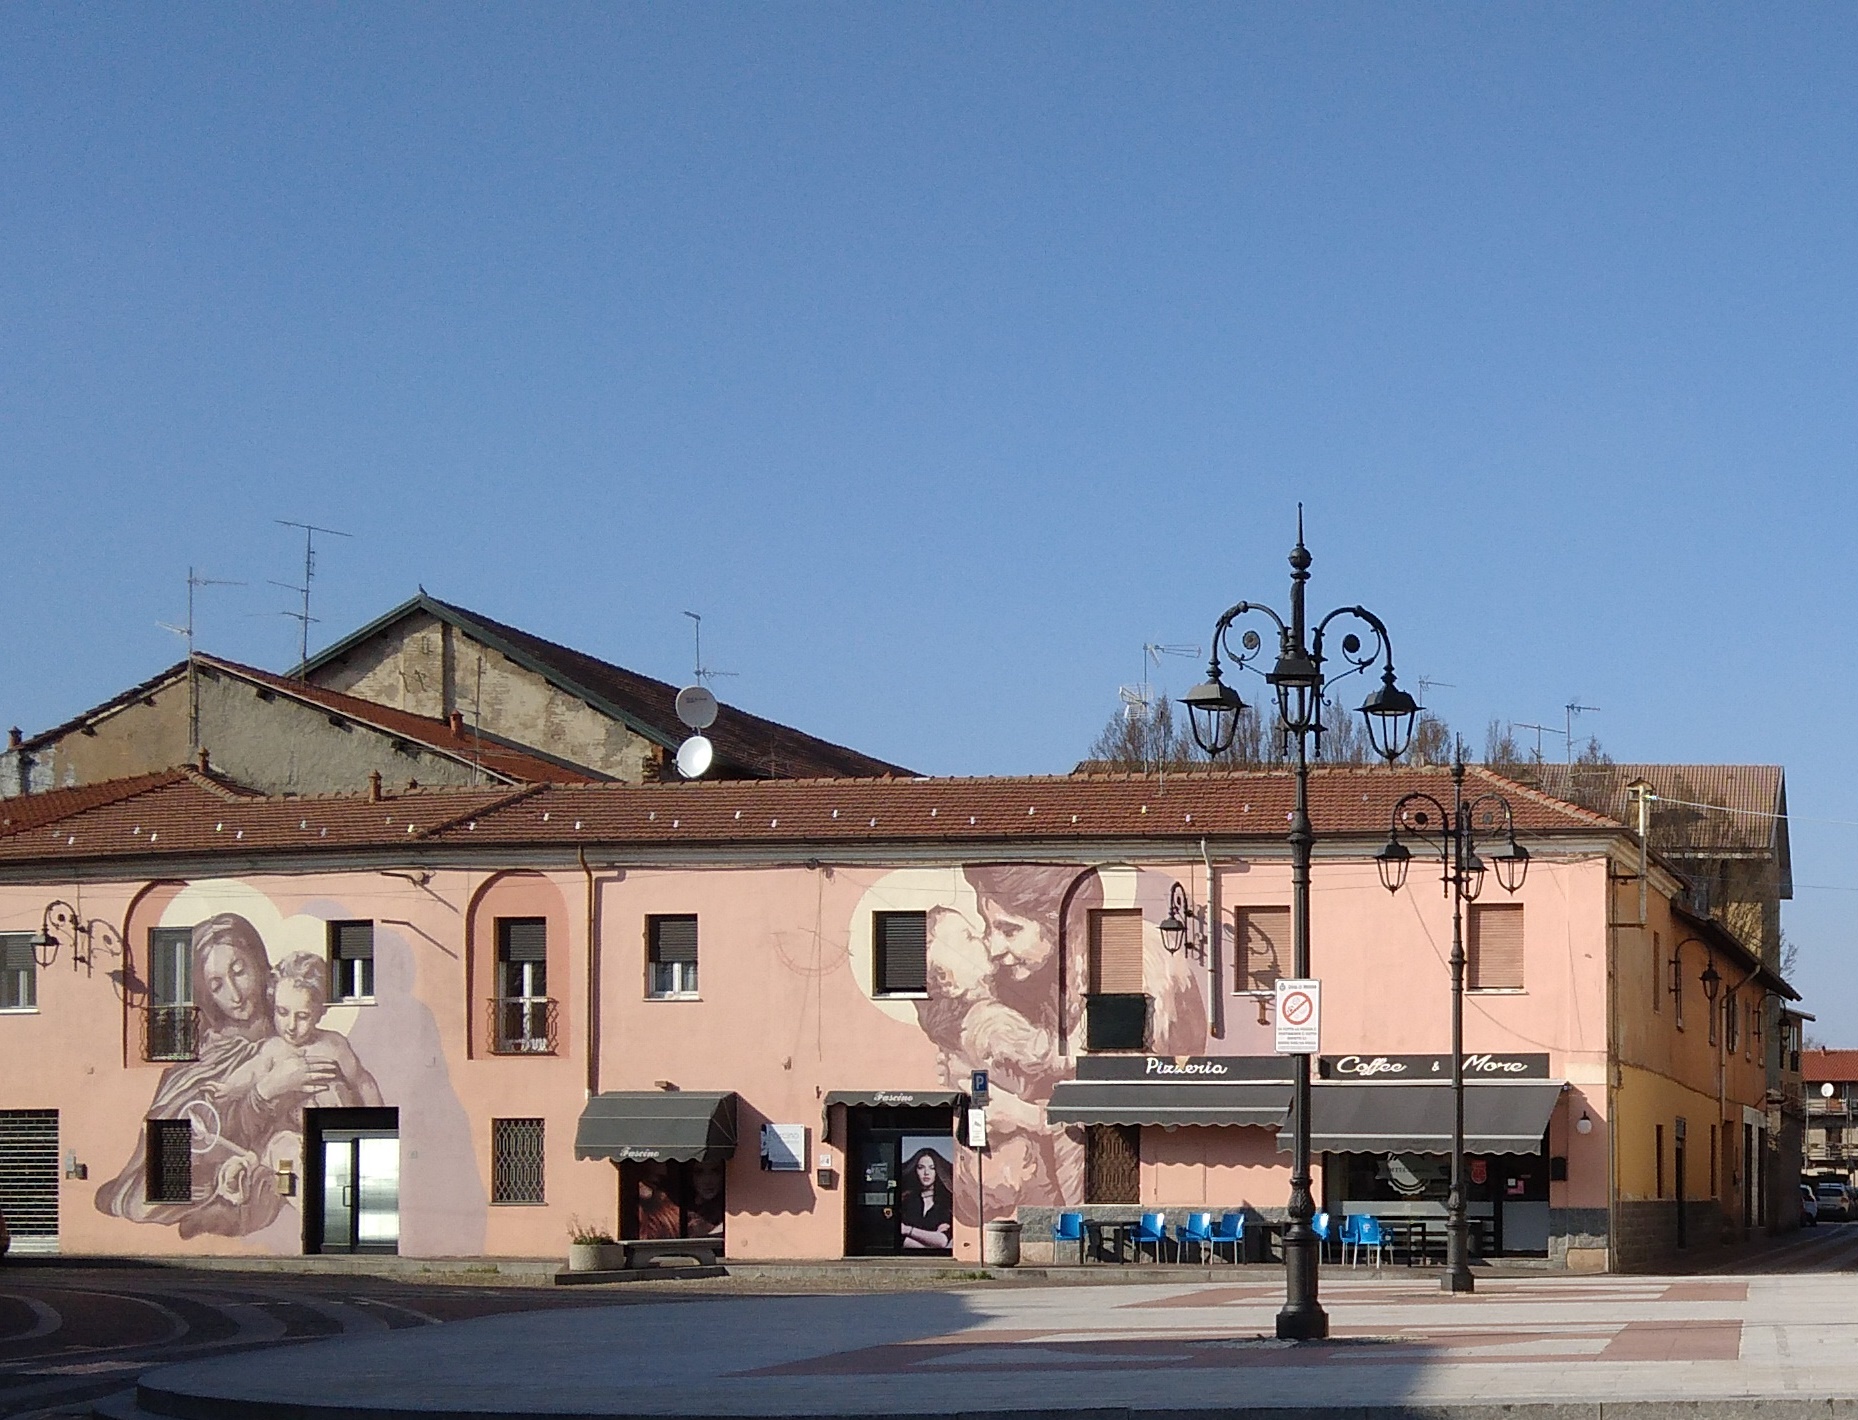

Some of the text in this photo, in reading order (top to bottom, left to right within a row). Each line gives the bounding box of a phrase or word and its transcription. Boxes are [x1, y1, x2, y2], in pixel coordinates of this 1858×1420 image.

[1145, 1057, 1228, 1075] Pizzeria
[1336, 1054, 1528, 1076] Coffee & More
[975, 1075, 984, 1090] P
